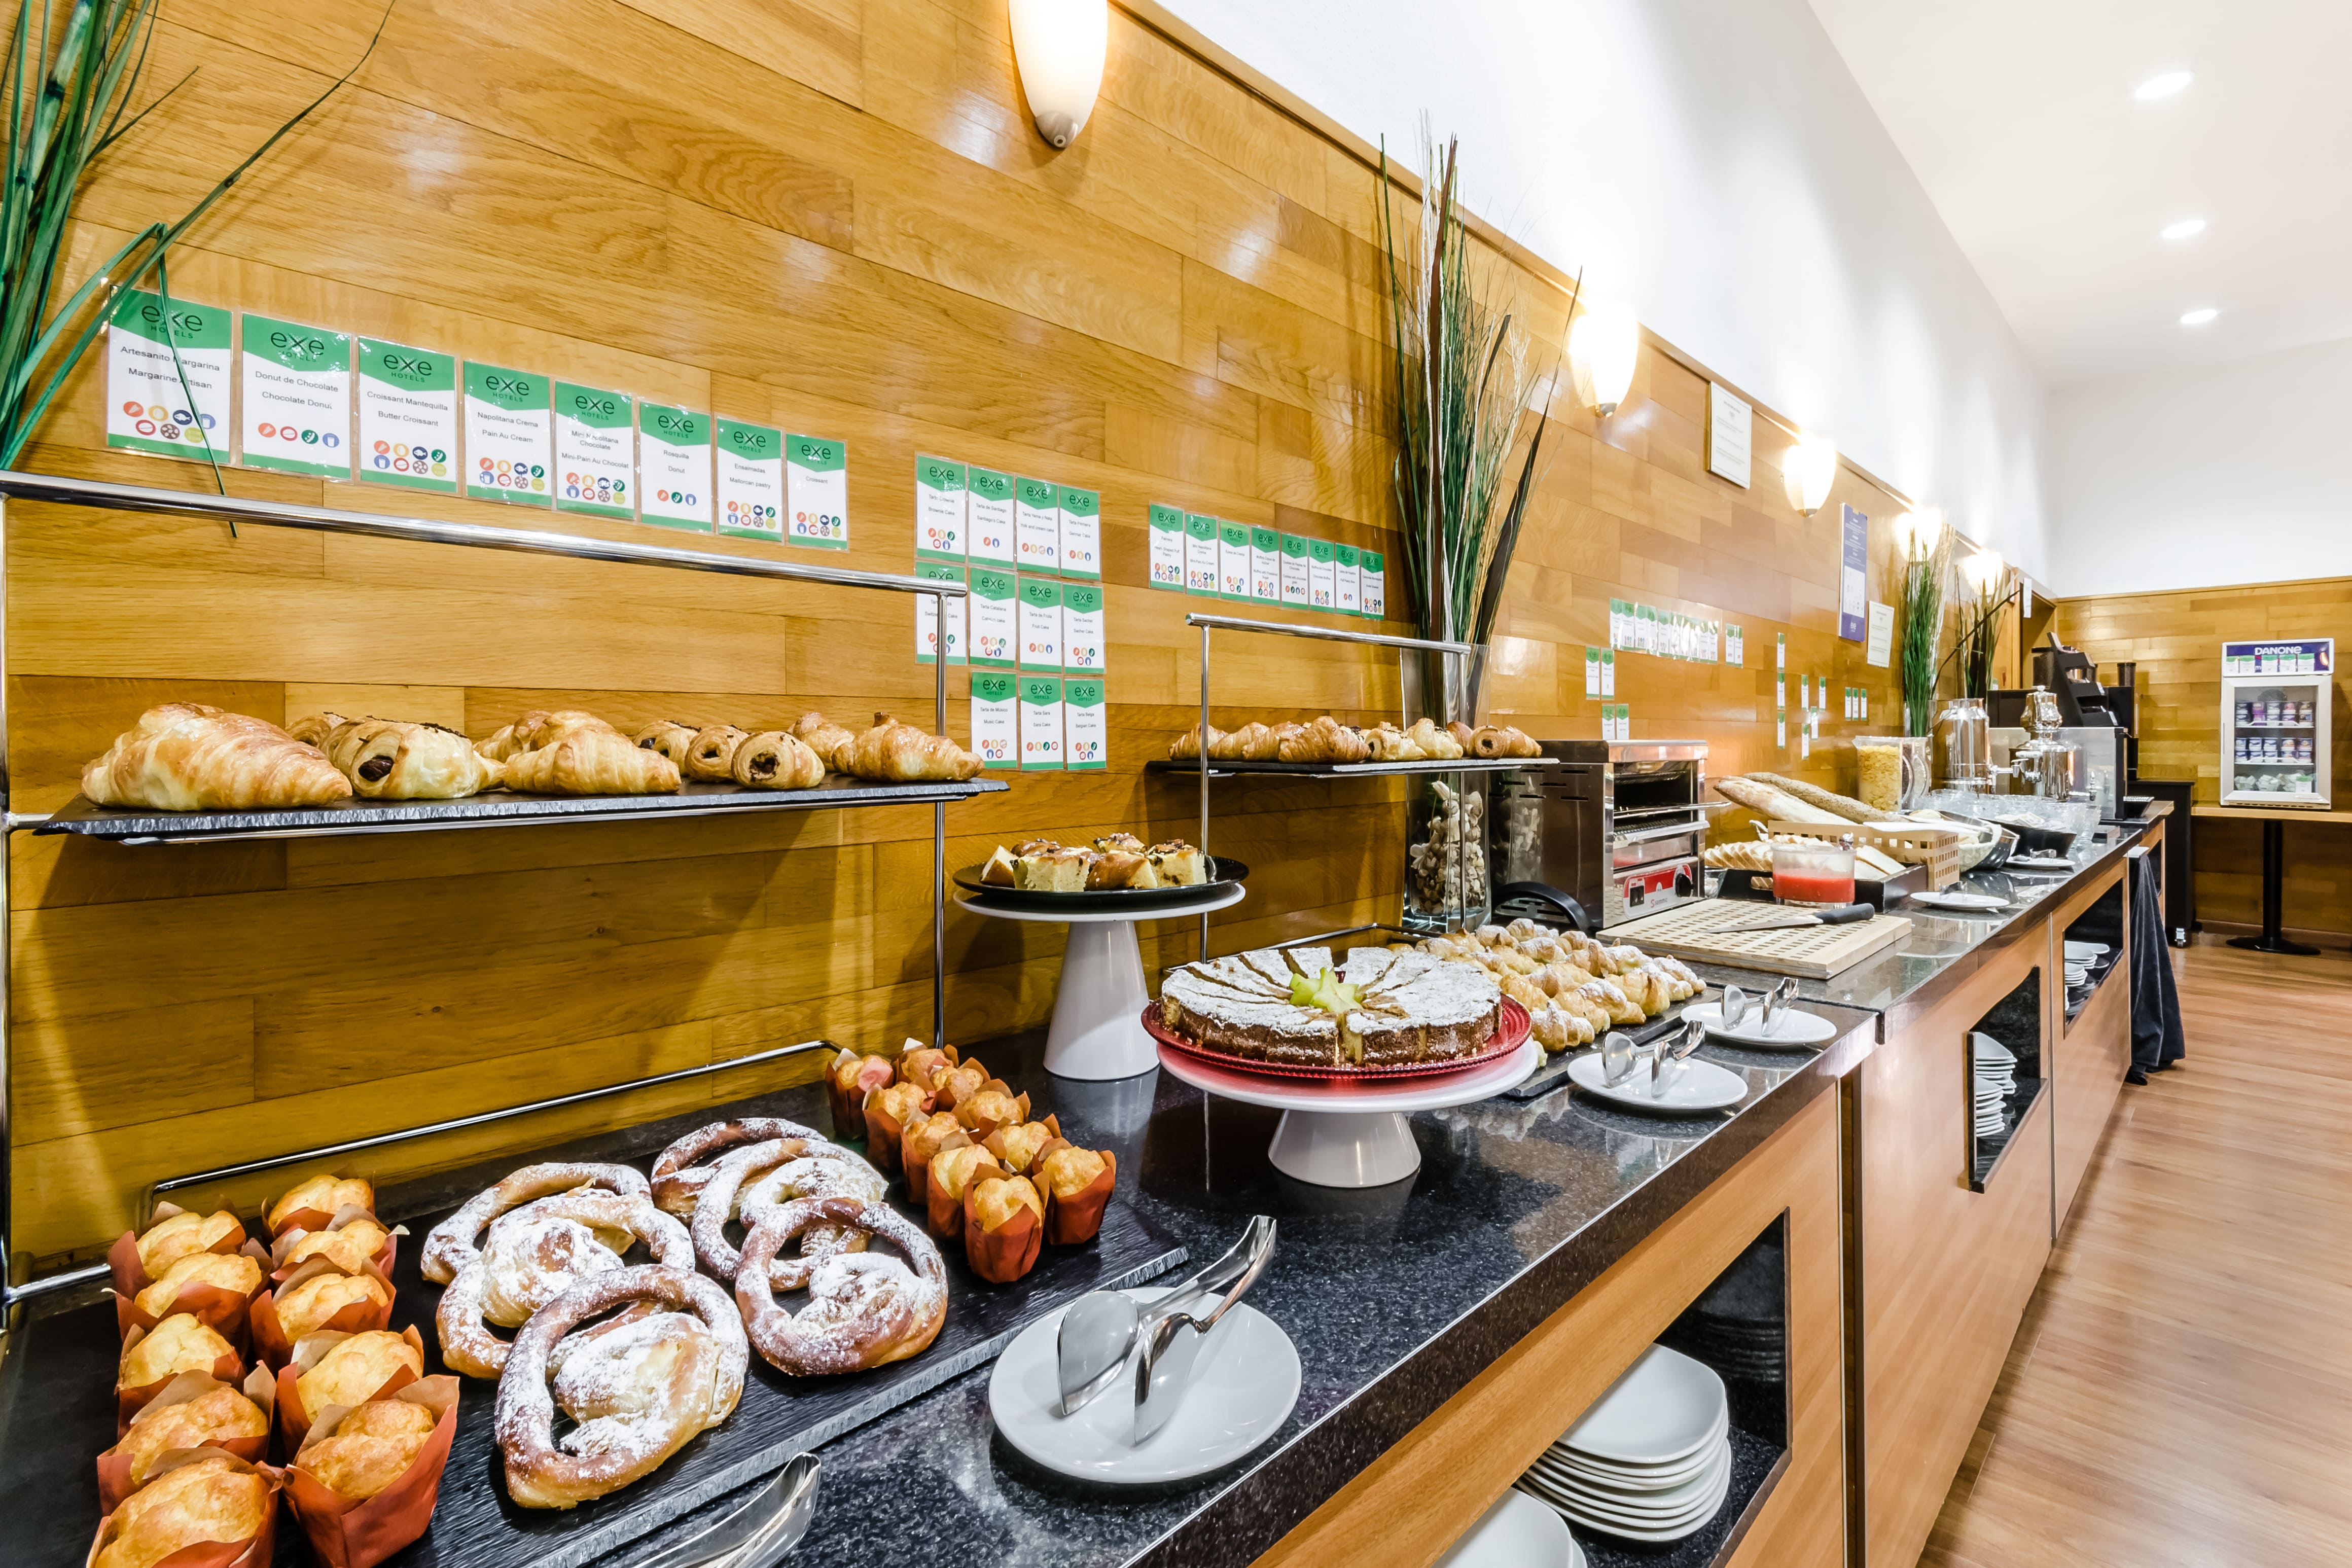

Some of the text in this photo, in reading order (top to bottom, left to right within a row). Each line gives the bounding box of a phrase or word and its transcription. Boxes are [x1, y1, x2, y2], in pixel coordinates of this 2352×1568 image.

[151, 326, 193, 339] HOELS
[121, 346, 220, 371] Artesanito argarina
[129, 368, 176, 383] Margarine
[256, 371, 338, 393] Donut de Chocolate
[391, 372, 425, 383] HOTELS
[262, 392, 304, 405] Chocolate
[367, 391, 448, 411] Croissant Mantequilla
[493, 393, 523, 402] HOTELS
[378, 411, 438, 426] Butter Croissant
[478, 412, 539, 428] Napolitana Crema
[582, 411, 609, 420] HOTELS
[482, 430, 498, 438] Pain
[510, 435, 532, 443] Cream
[580, 440, 611, 450] Chocolate
[562, 452, 590, 462] Mini-Pain
[602, 459, 629, 469] Chocolat
[663, 450, 689, 459] Rosquilla
[668, 466, 685, 474] Donut
[734, 464, 766, 474] Ensaimadas
[730, 477, 755, 486] Mallorcan
[806, 476, 828, 484] Croissant
